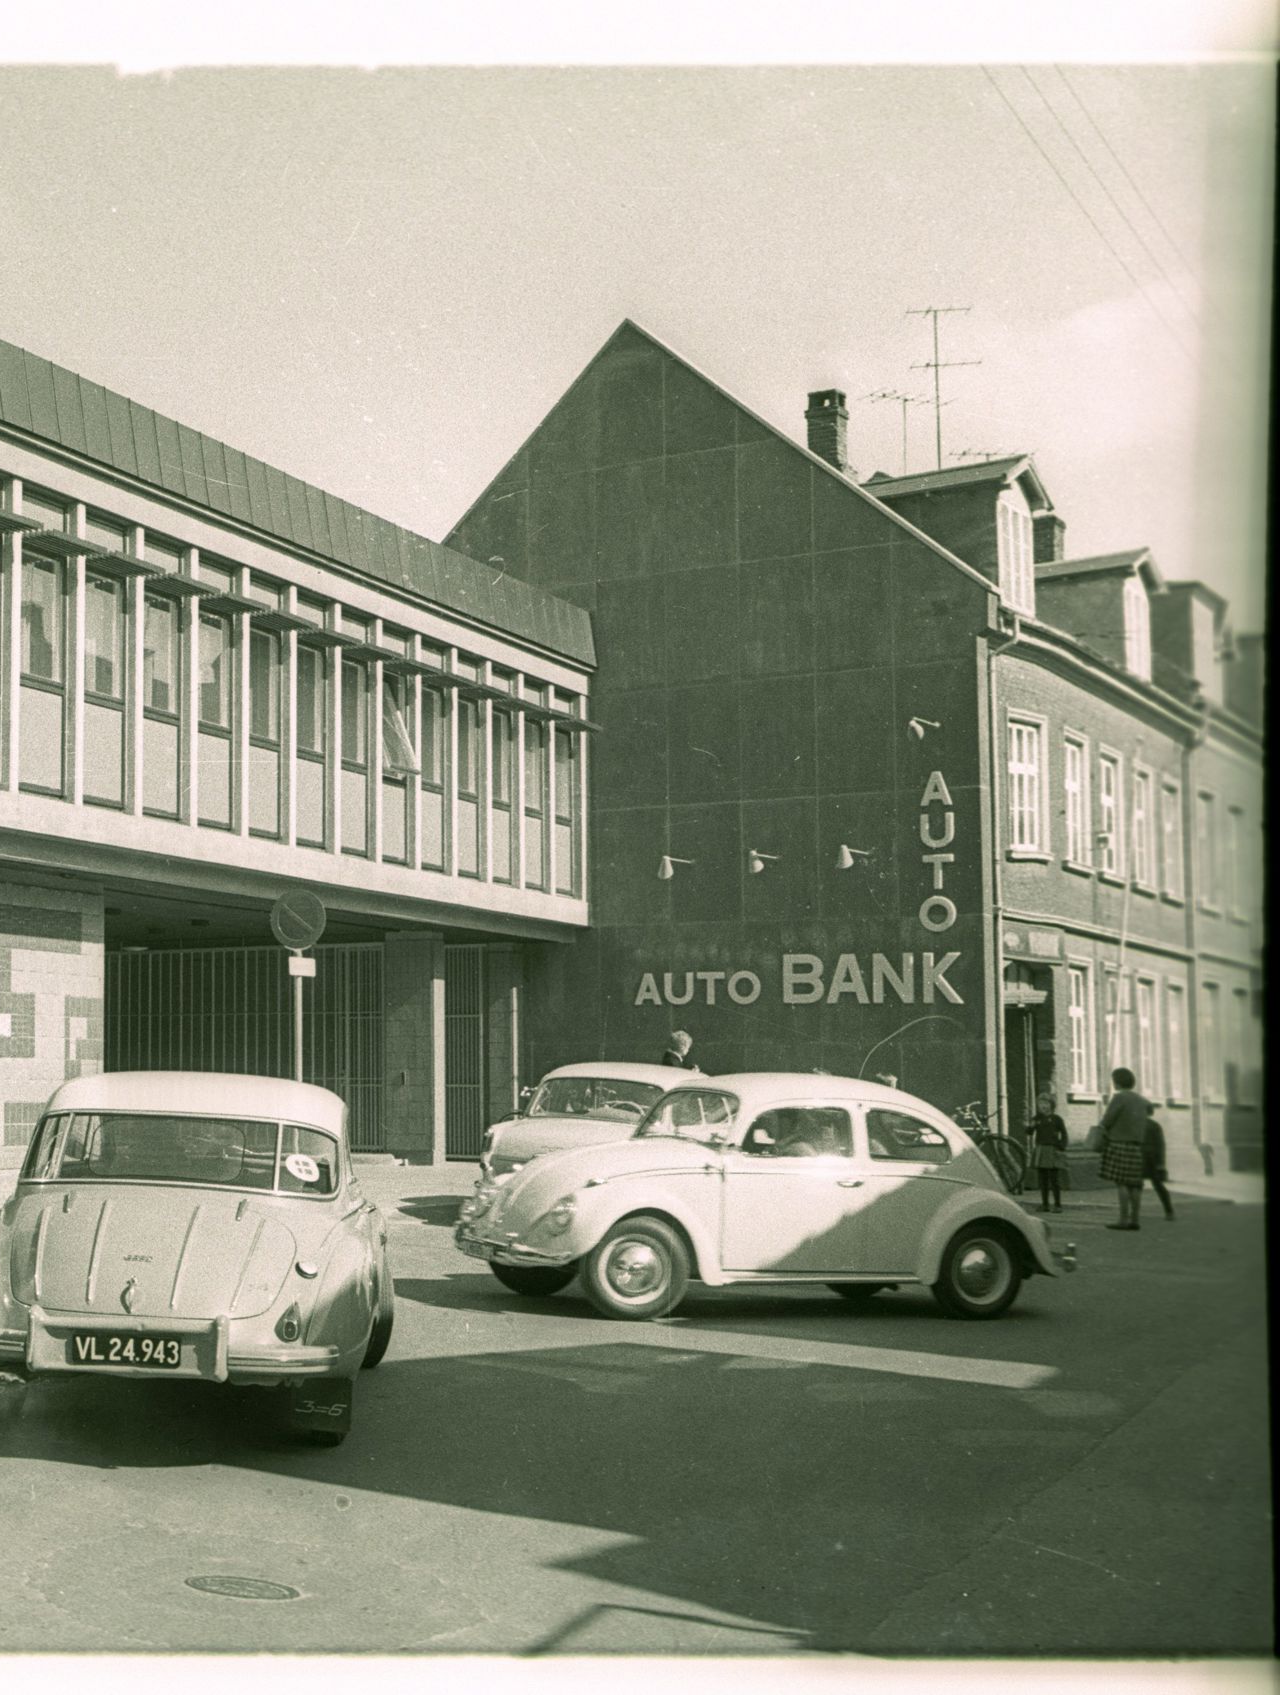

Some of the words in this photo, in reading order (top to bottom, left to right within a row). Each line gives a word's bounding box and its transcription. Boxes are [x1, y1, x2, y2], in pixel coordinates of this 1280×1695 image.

[919, 770, 957, 932] AUTO
[634, 970, 761, 1005] AUTO
[782, 951, 965, 1004] BANK
[76, 1336, 105, 1361] VL
[109, 1338, 179, 1364] 24.943
